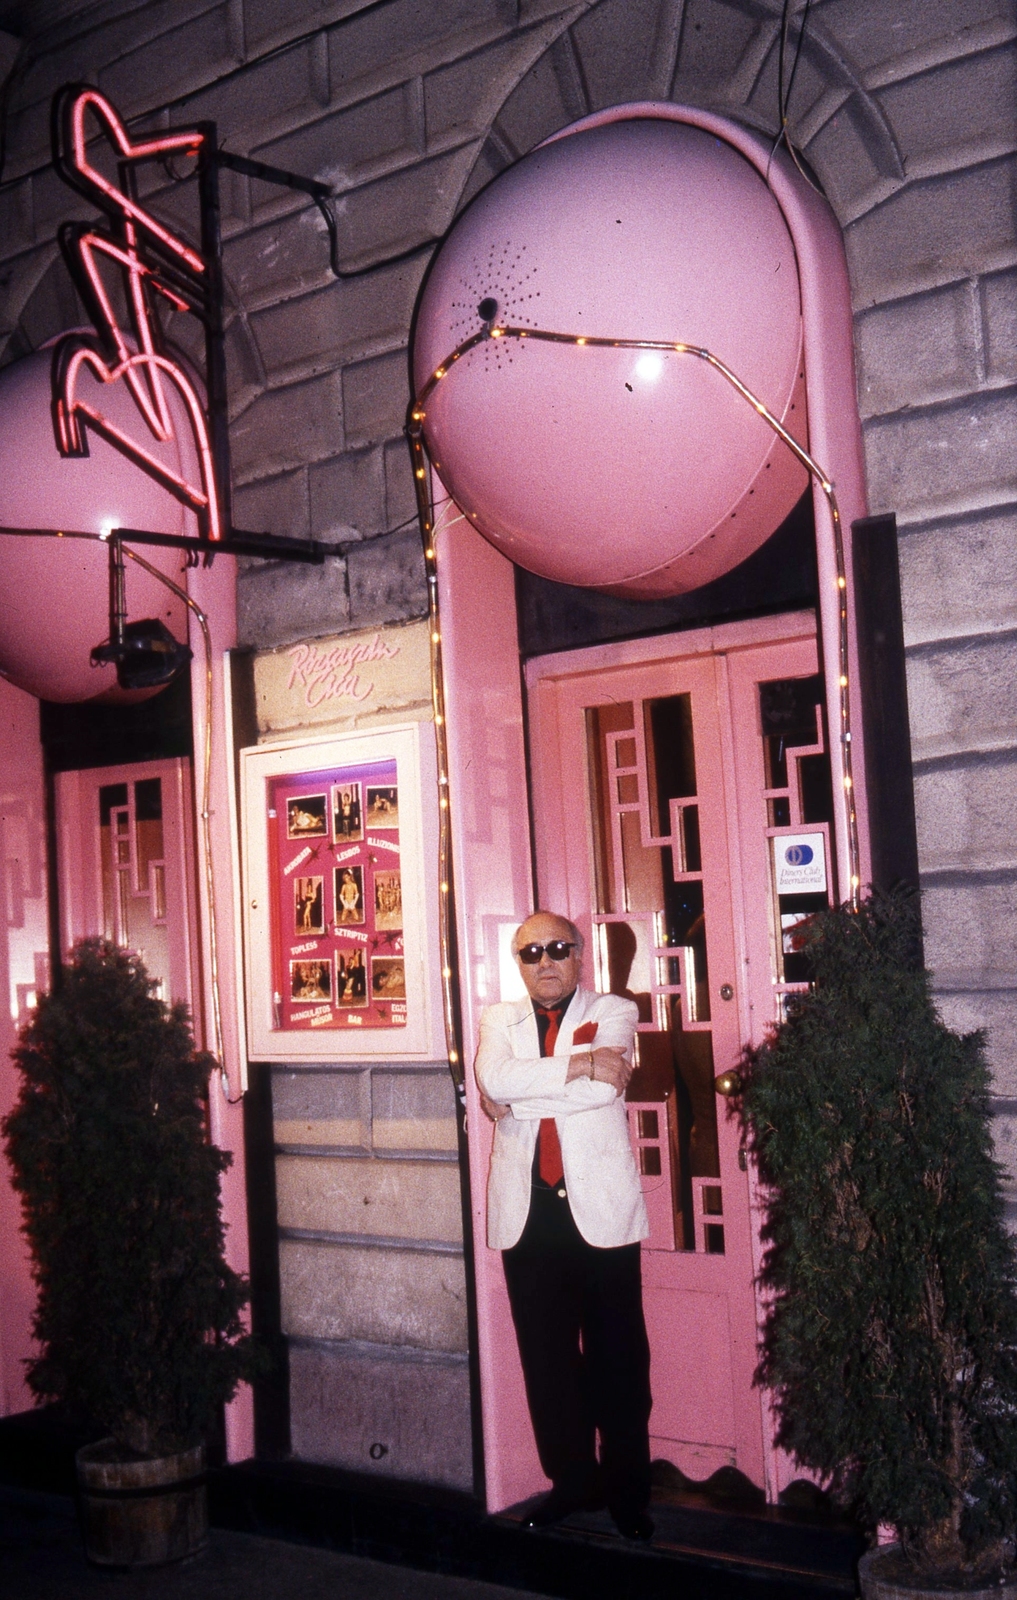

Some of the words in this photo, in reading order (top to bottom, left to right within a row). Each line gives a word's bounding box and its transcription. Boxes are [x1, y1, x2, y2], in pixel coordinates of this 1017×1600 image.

[781, 868, 803, 877] Diners
[804, 867, 821, 875] Club
[779, 875, 823, 885] International
[290, 941, 318, 955] TOPLESS
